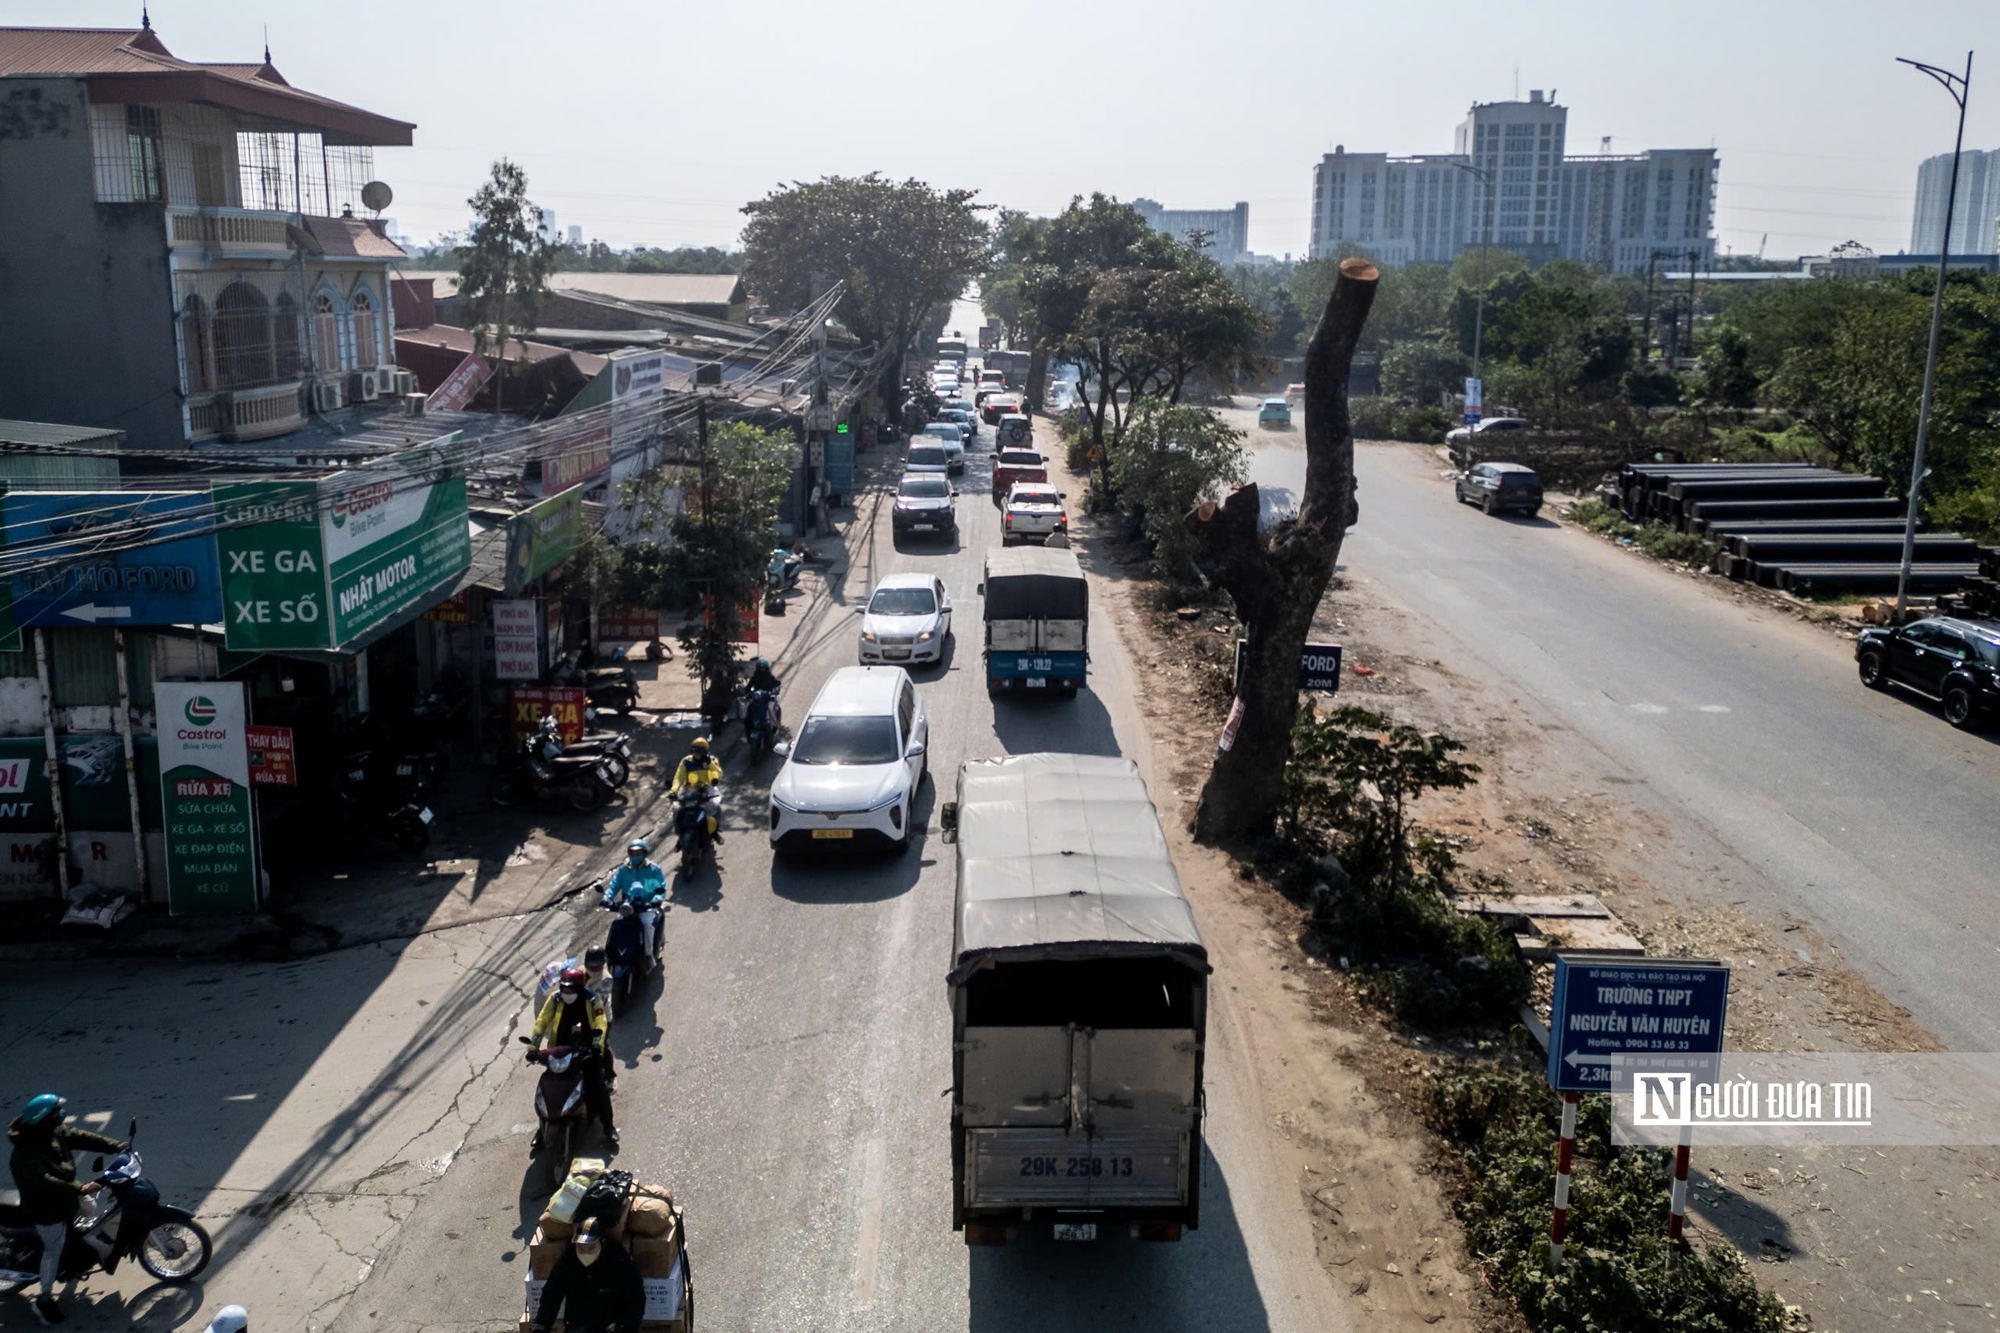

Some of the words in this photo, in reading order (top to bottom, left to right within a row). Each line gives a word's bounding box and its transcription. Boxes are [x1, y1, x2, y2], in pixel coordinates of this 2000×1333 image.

[350, 521, 366, 537] Bike
[367, 512, 386, 529] Point
[228, 550, 266, 573] XE
[274, 550, 317, 573] GA
[121, 565, 196, 592] FORD
[339, 575, 374, 616] NHẬT
[375, 555, 416, 595] MOTOR
[234, 600, 271, 623] XE
[279, 593, 318, 623] SỐ
[516, 702, 543, 722] XE
[177, 729, 226, 740] Castrol
[247, 733, 269, 747] THAY
[271, 730, 289, 749] DẦU
[254, 769, 274, 783] RỬA
[275, 773, 287, 783] XE
[177, 779, 208, 796] RỬA
[213, 782, 232, 797] XE
[178, 802, 201, 814] SỬA
[203, 801, 236, 814] CHỮA
[171, 824, 184, 834] XE
[187, 824, 204, 834] GA
[213, 824, 227, 834] XE
[229, 819, 245, 834] SỐ
[175, 844, 188, 854] XE
[191, 844, 214, 855] ĐẠP
[217, 841, 244, 854] ĐIỆN
[184, 863, 211, 873] MUA
[214, 860, 237, 873] BÁN
[196, 883, 210, 893] XE
[1620, 971, 1635, 981] DỤC
[1637, 970, 1647, 979] VÀ
[1597, 983, 1653, 1005] TRƯỜNG
[1657, 989, 1693, 1006] THPT
[1569, 1010, 1628, 1032] NGUYỄN
[1631, 1013, 1659, 1034] VĂN
[1663, 1015, 1710, 1035] HUYÊN
[1625, 1039, 1649, 1048] 0904
[1650, 1040, 1662, 1049] 33
[1664, 1040, 1675, 1050] 65
[1677, 1040, 1689, 1050] 33
[1579, 1067, 1622, 1082] 2,3km
